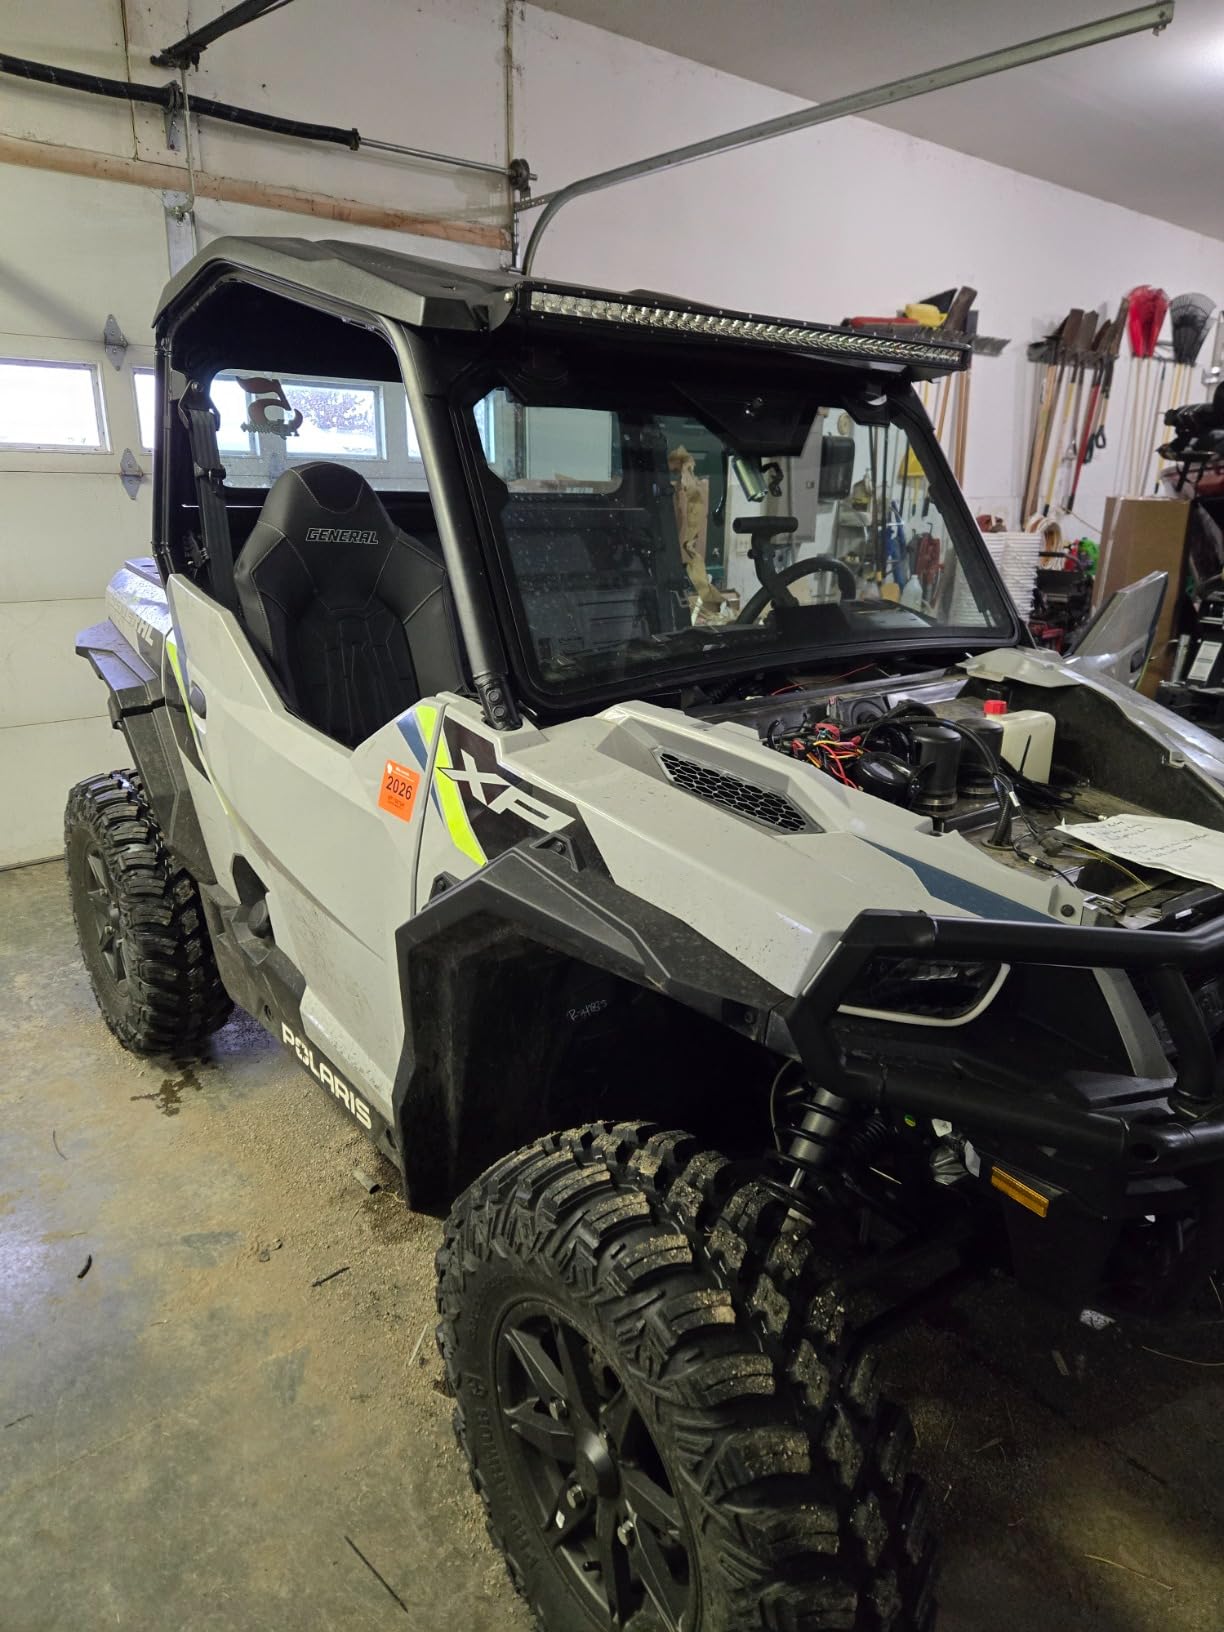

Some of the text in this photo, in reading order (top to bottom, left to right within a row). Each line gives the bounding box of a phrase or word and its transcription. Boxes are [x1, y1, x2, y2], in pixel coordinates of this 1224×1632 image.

[306, 527, 379, 545] GENERAL
[385, 775, 413, 801] 2026
[436, 749, 577, 833] XP
[281, 1021, 372, 1130] POLARIS
